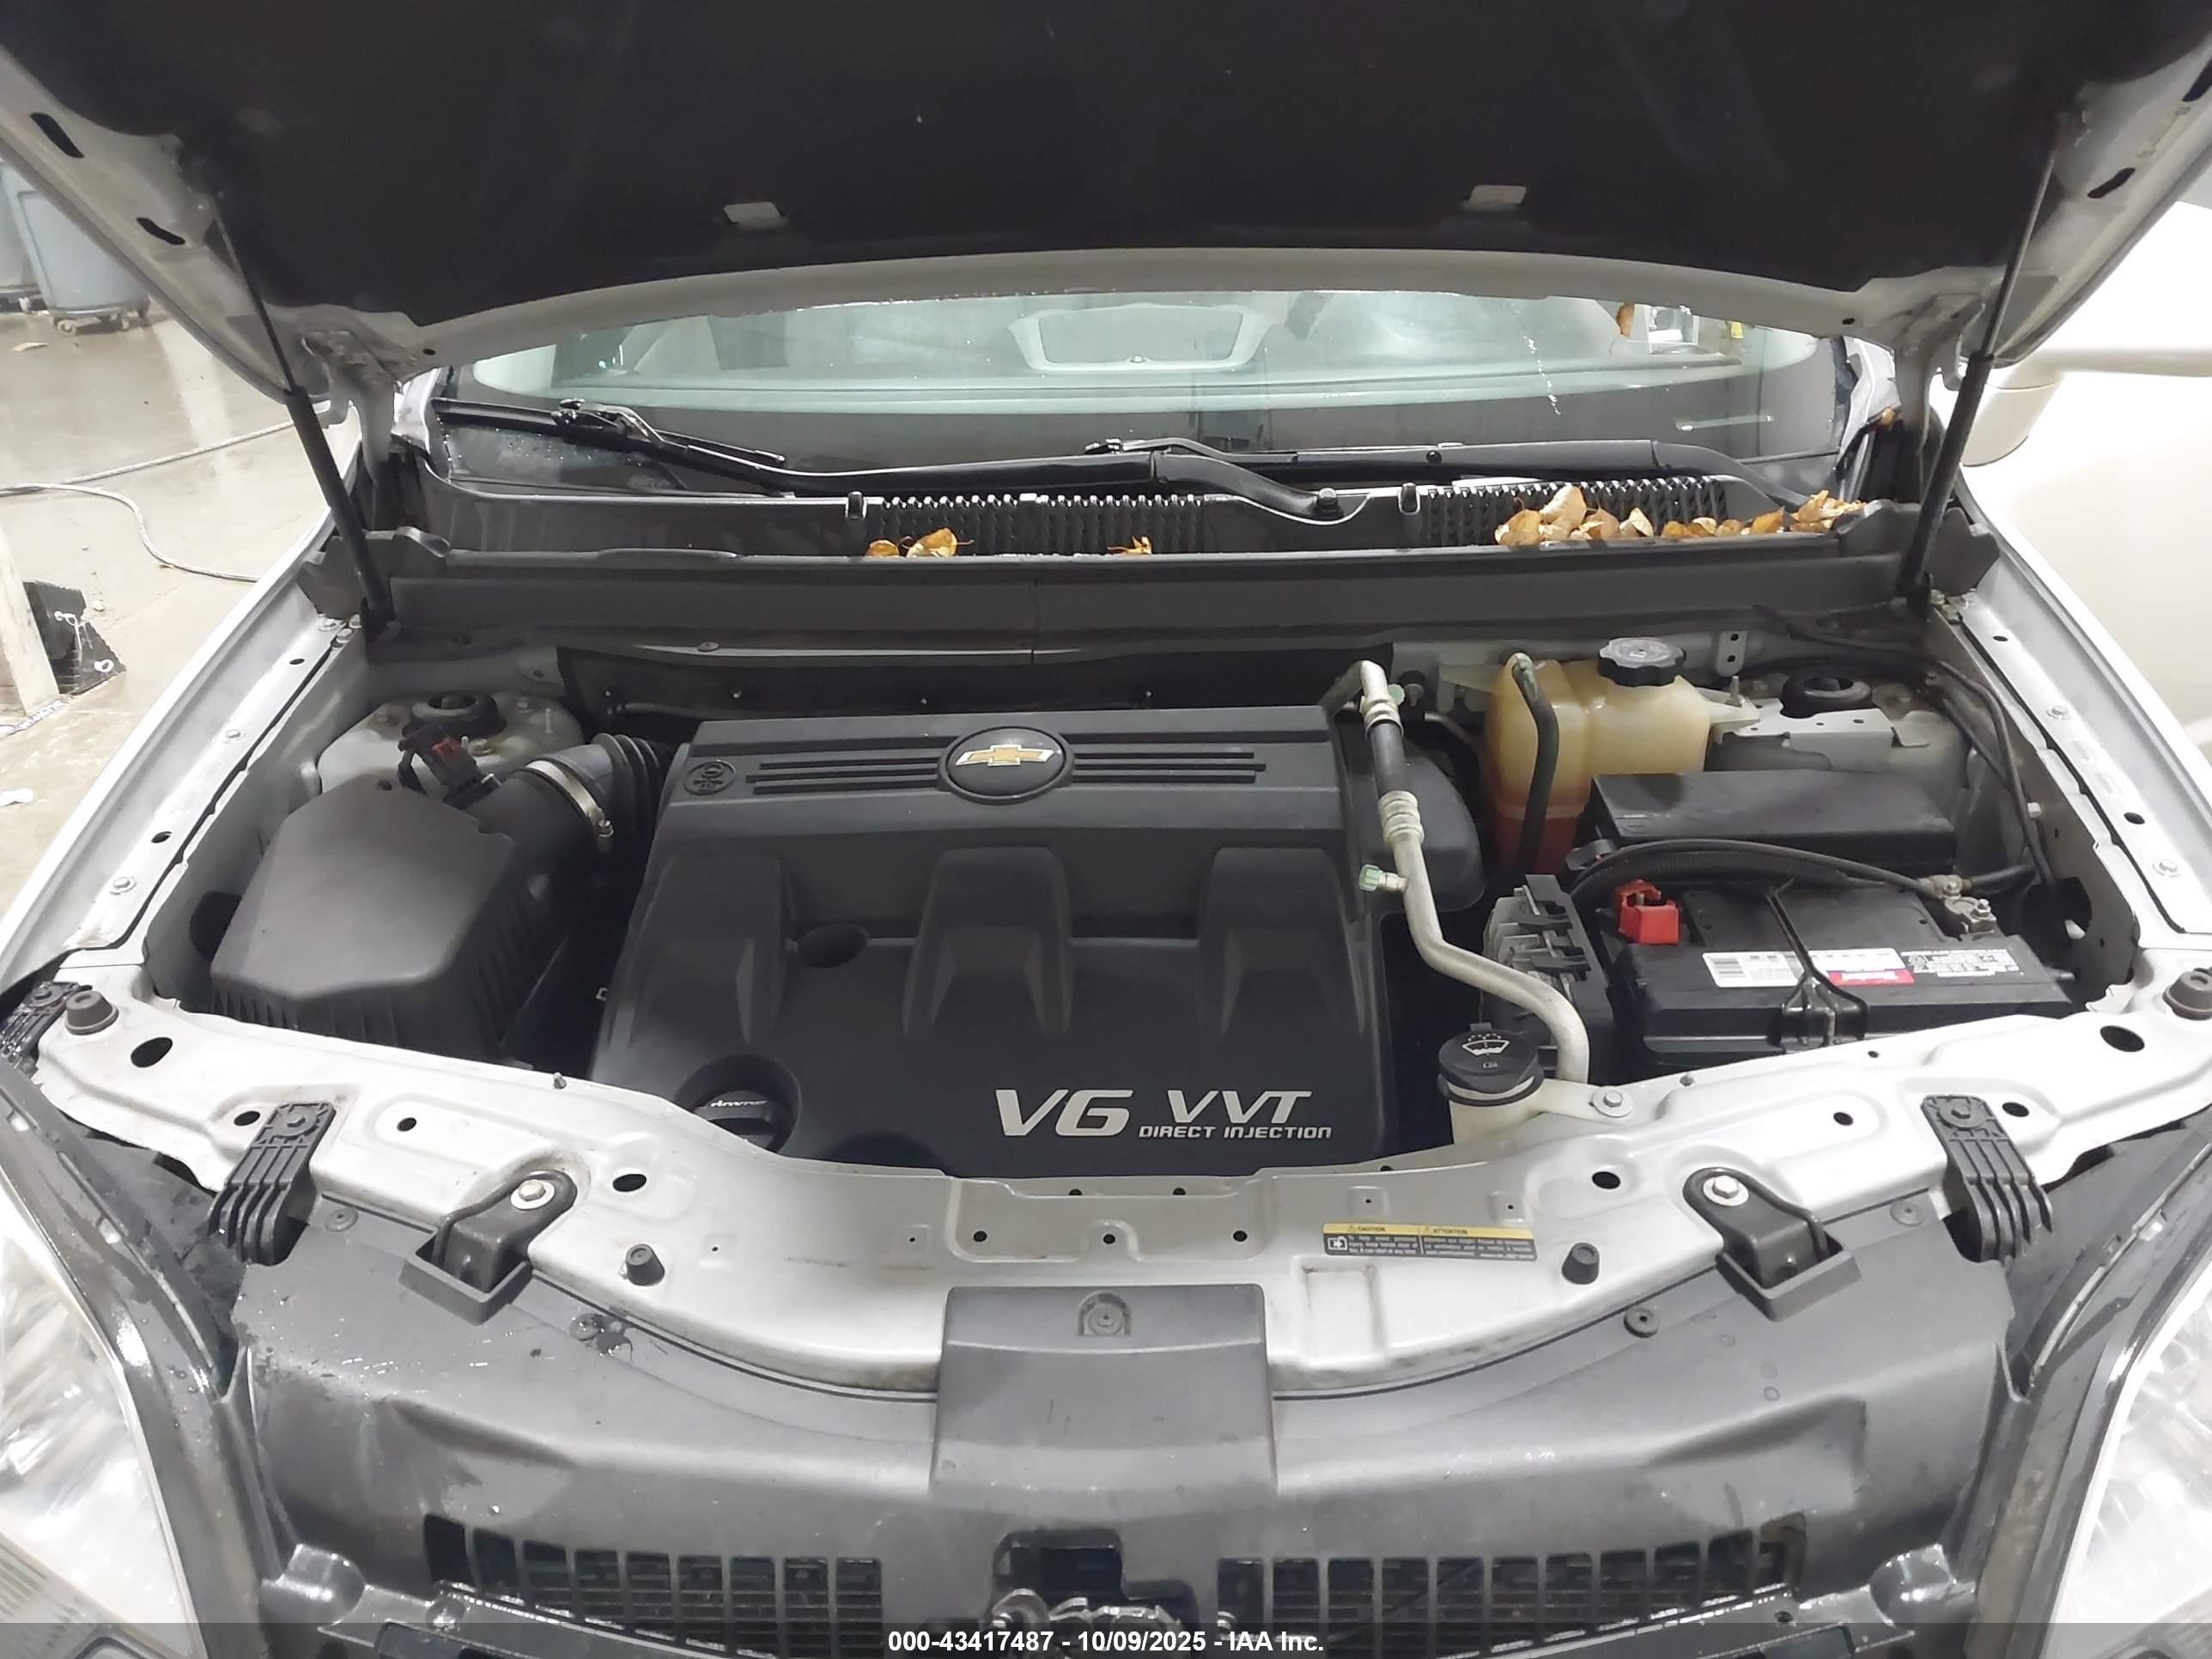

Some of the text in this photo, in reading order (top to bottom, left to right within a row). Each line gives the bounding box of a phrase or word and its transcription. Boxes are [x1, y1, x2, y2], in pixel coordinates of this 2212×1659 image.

[995, 1089, 1313, 1137] V6 VVT
[1139, 1125, 1333, 1139] DIRECT INJECTION
